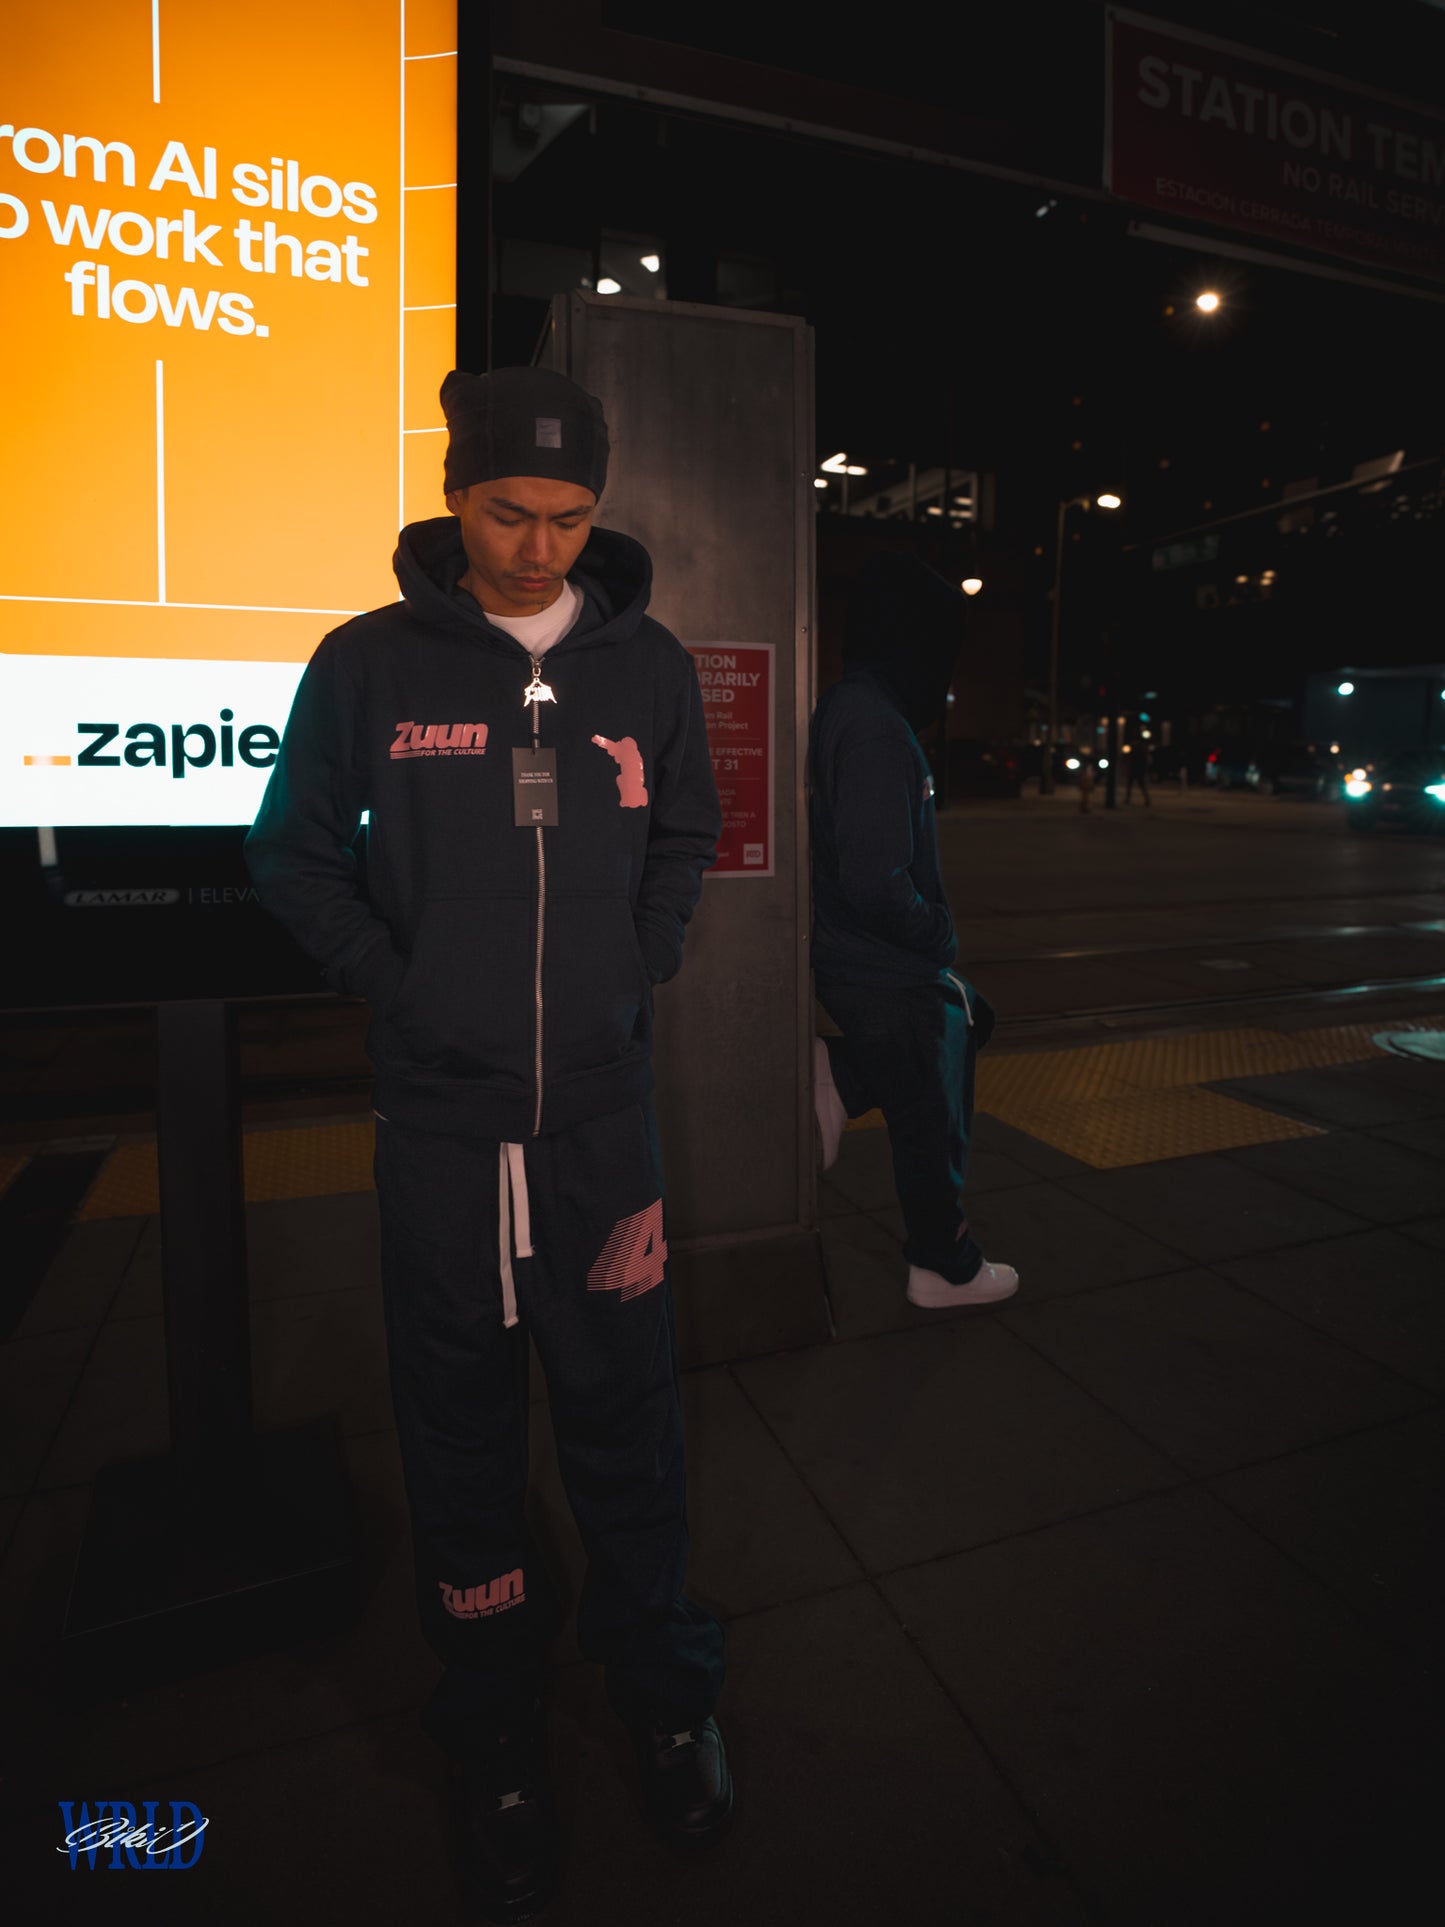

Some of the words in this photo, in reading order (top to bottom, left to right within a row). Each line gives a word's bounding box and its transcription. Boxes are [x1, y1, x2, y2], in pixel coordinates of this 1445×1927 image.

[1137, 55, 1351, 161] STATION
[149, 140, 217, 200] AI
[231, 156, 378, 225] silos
[1282, 161, 1321, 193] NO
[1328, 173, 1380, 209] RAIL
[1386, 189, 1445, 226] SERV
[40, 199, 224, 267] work
[233, 218, 370, 288] that
[64, 260, 270, 338] flows.
[698, 671, 761, 687] RARILY
[716, 711, 733, 720] Rail
[718, 720, 749, 732] Project
[389, 720, 489, 752] Zuun
[421, 749, 437, 757] FOR
[438, 748, 453, 756] THE
[453, 747, 487, 756] CULTURE
[715, 747, 764, 757] EFFECTIVE
[724, 758, 739, 771] 31
[74, 890, 169, 905] LAMAR
[438, 1567, 525, 1615] Zuun
